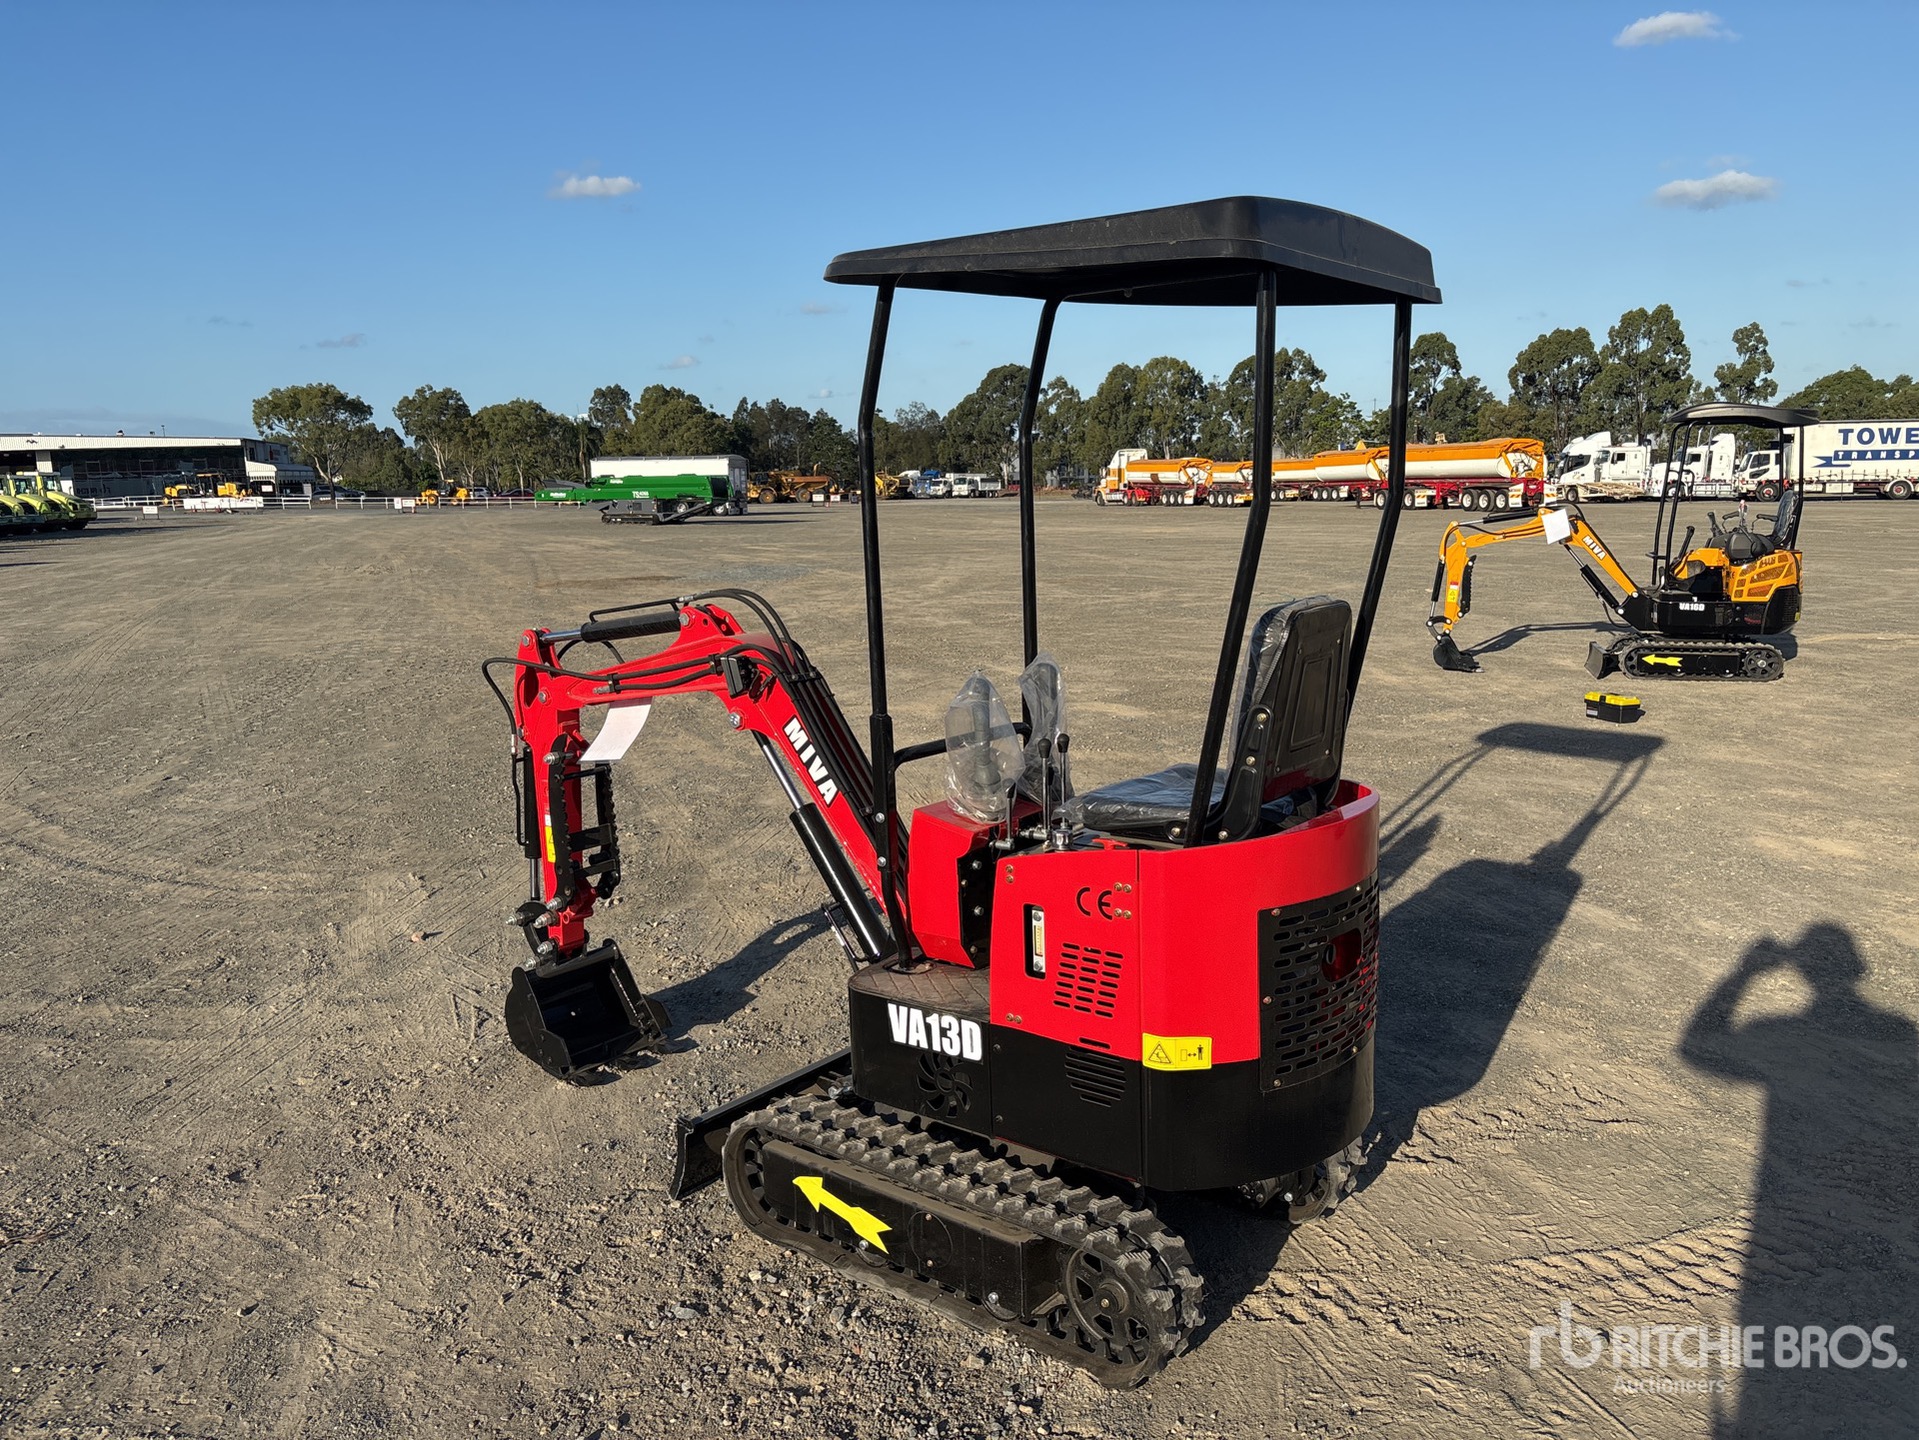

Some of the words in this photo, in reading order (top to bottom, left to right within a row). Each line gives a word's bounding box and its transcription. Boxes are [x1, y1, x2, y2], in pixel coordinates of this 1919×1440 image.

[1838, 427, 1919, 445] TOWE
[1838, 450, 1916, 460] TRANSP
[1583, 535, 1605, 560] MIVA
[1679, 602, 1705, 611] VA16D
[784, 717, 838, 806] MIVA
[1076, 886, 1113, 921] CE
[887, 1003, 982, 1061] VA13D
